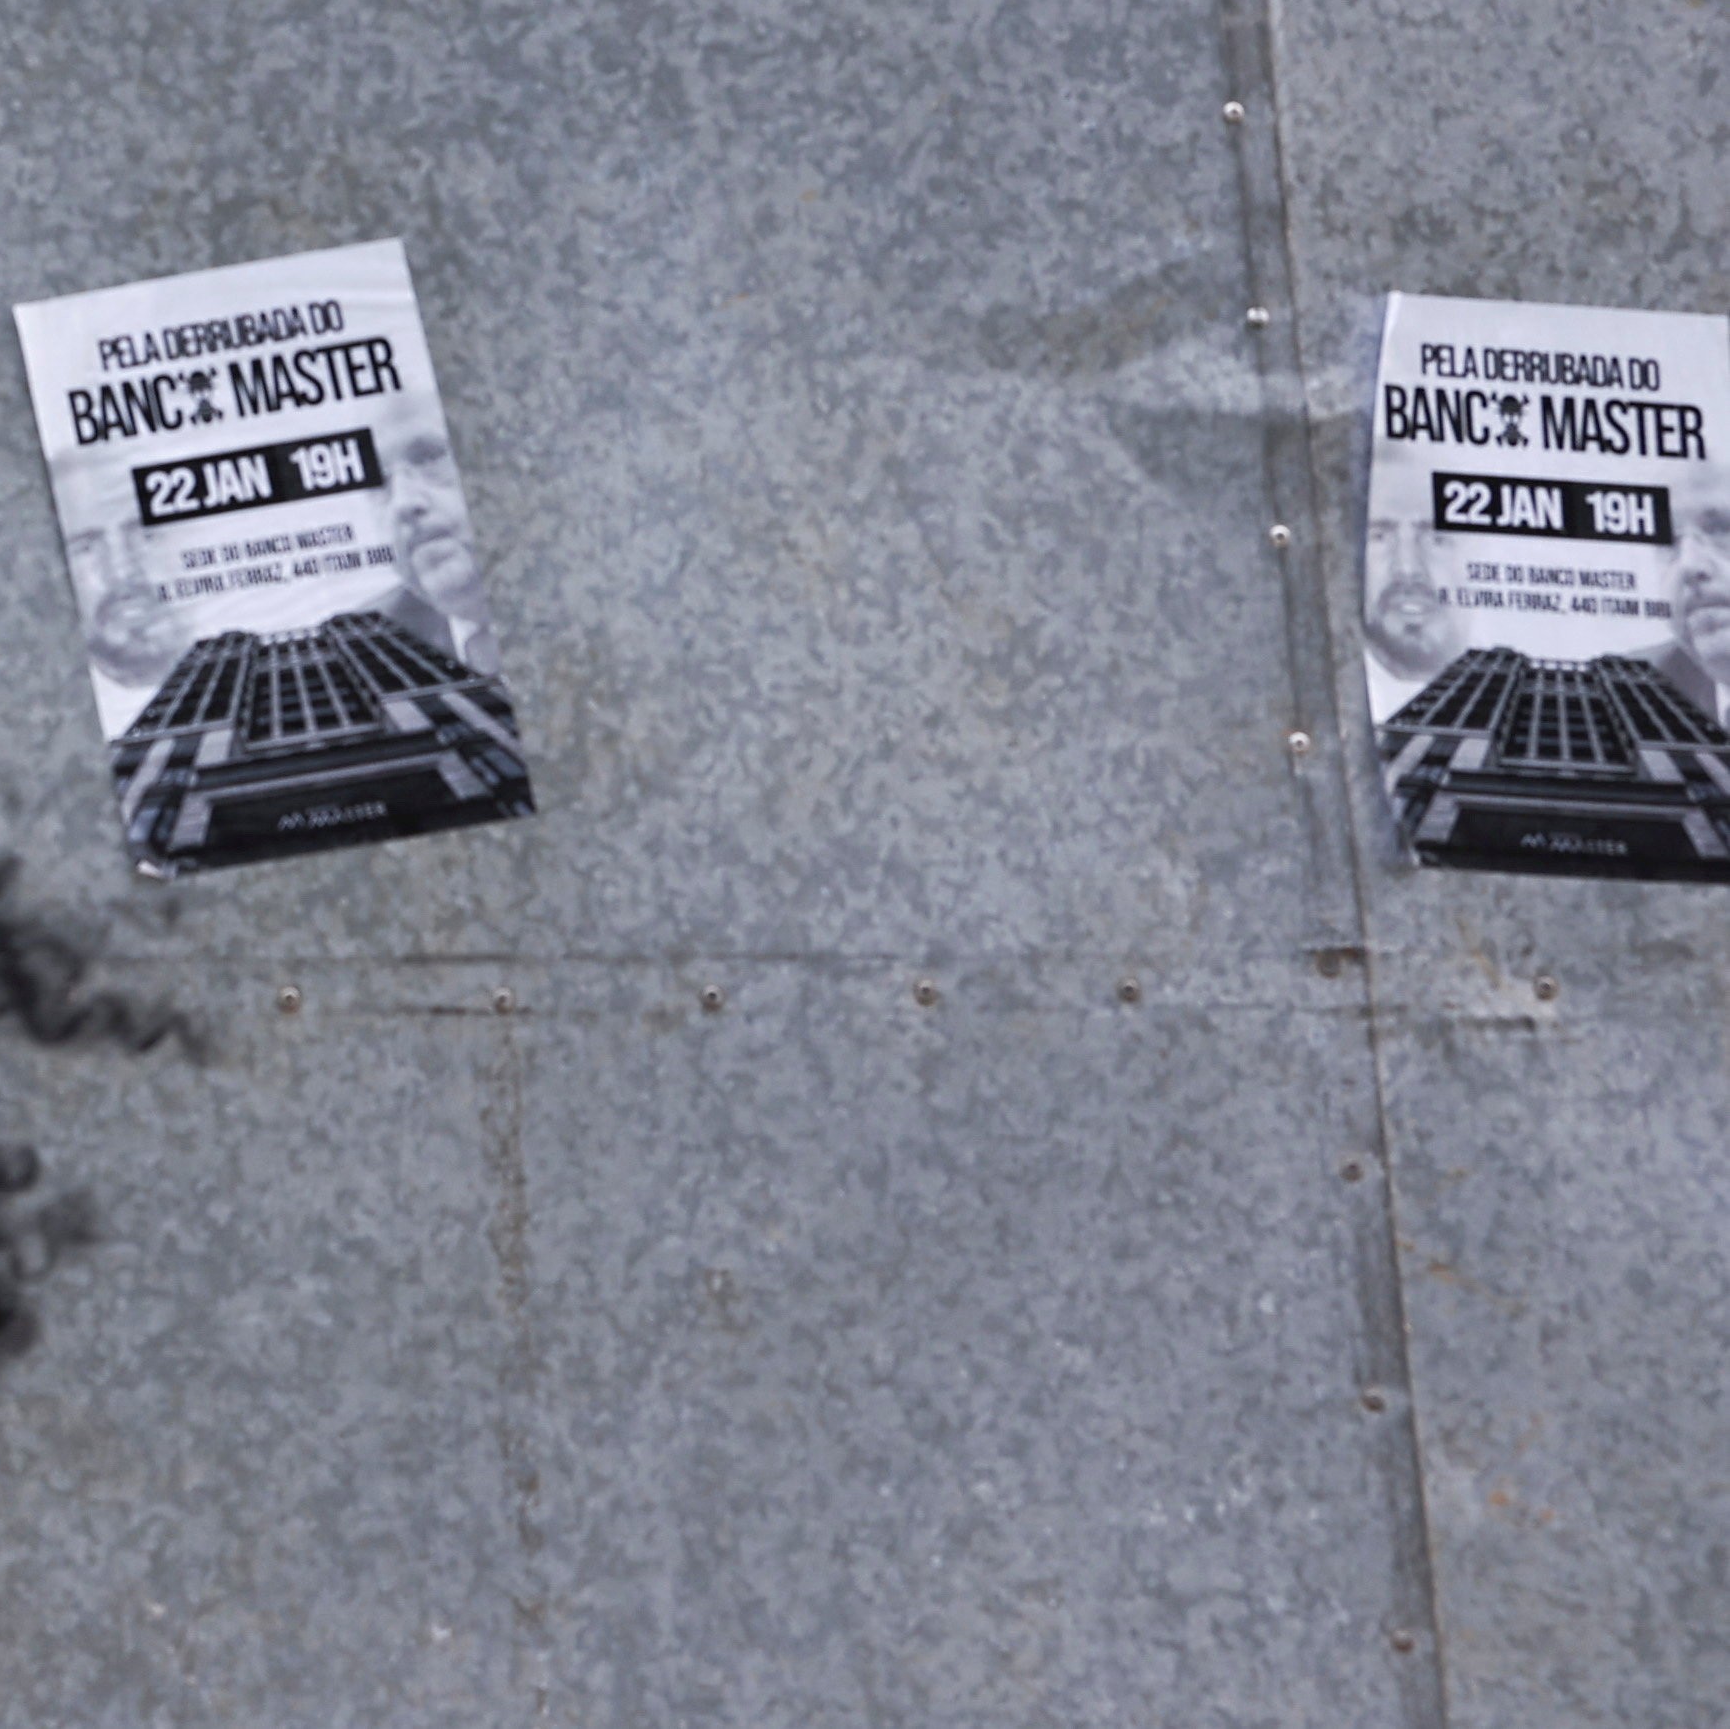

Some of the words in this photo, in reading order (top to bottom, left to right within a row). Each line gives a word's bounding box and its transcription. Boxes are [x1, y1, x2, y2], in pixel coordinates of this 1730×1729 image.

[98, 332, 160, 371] PELA
[163, 305, 307, 360] DERRUBADA
[309, 299, 343, 335] DO
[1421, 343, 1478, 379] PELA
[1483, 348, 1623, 388] DERRUBADA
[1628, 358, 1660, 391] DO
[228, 336, 401, 417] MASTER
[1540, 395, 1706, 460] MASTER
[145, 469, 200, 517] 22
[202, 455, 271, 508] JAN
[290, 439, 365, 492] 19H
[1444, 481, 1491, 525] 22
[1496, 486, 1564, 530] JAN
[1586, 492, 1655, 535] 19H
